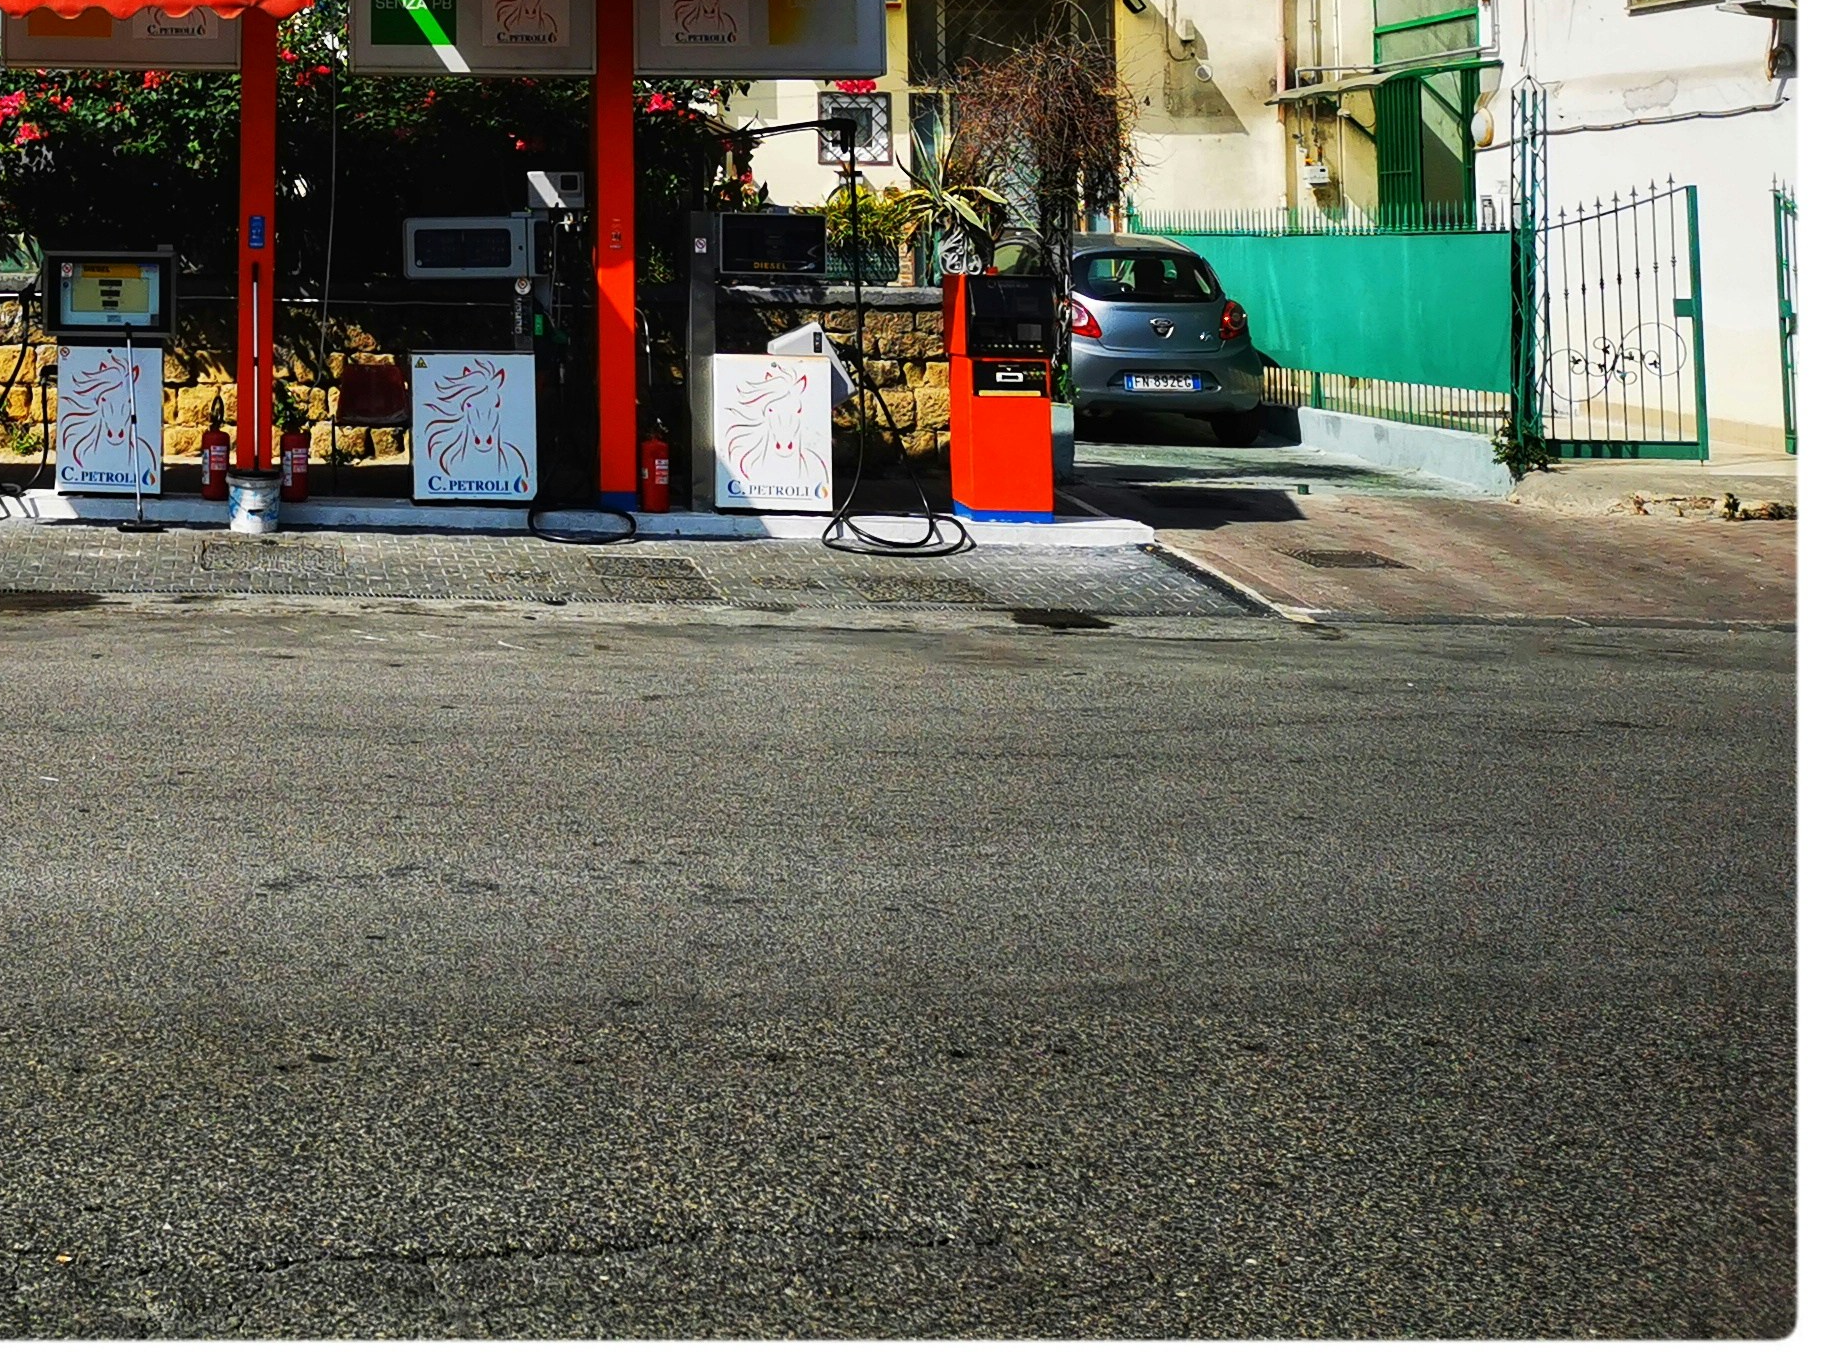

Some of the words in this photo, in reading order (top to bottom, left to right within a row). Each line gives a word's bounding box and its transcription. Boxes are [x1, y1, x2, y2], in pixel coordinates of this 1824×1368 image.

[753, 261, 787, 270] DIESEL
[449, 480, 509, 492] PETROLI
[749, 485, 810, 497] PETROLI
